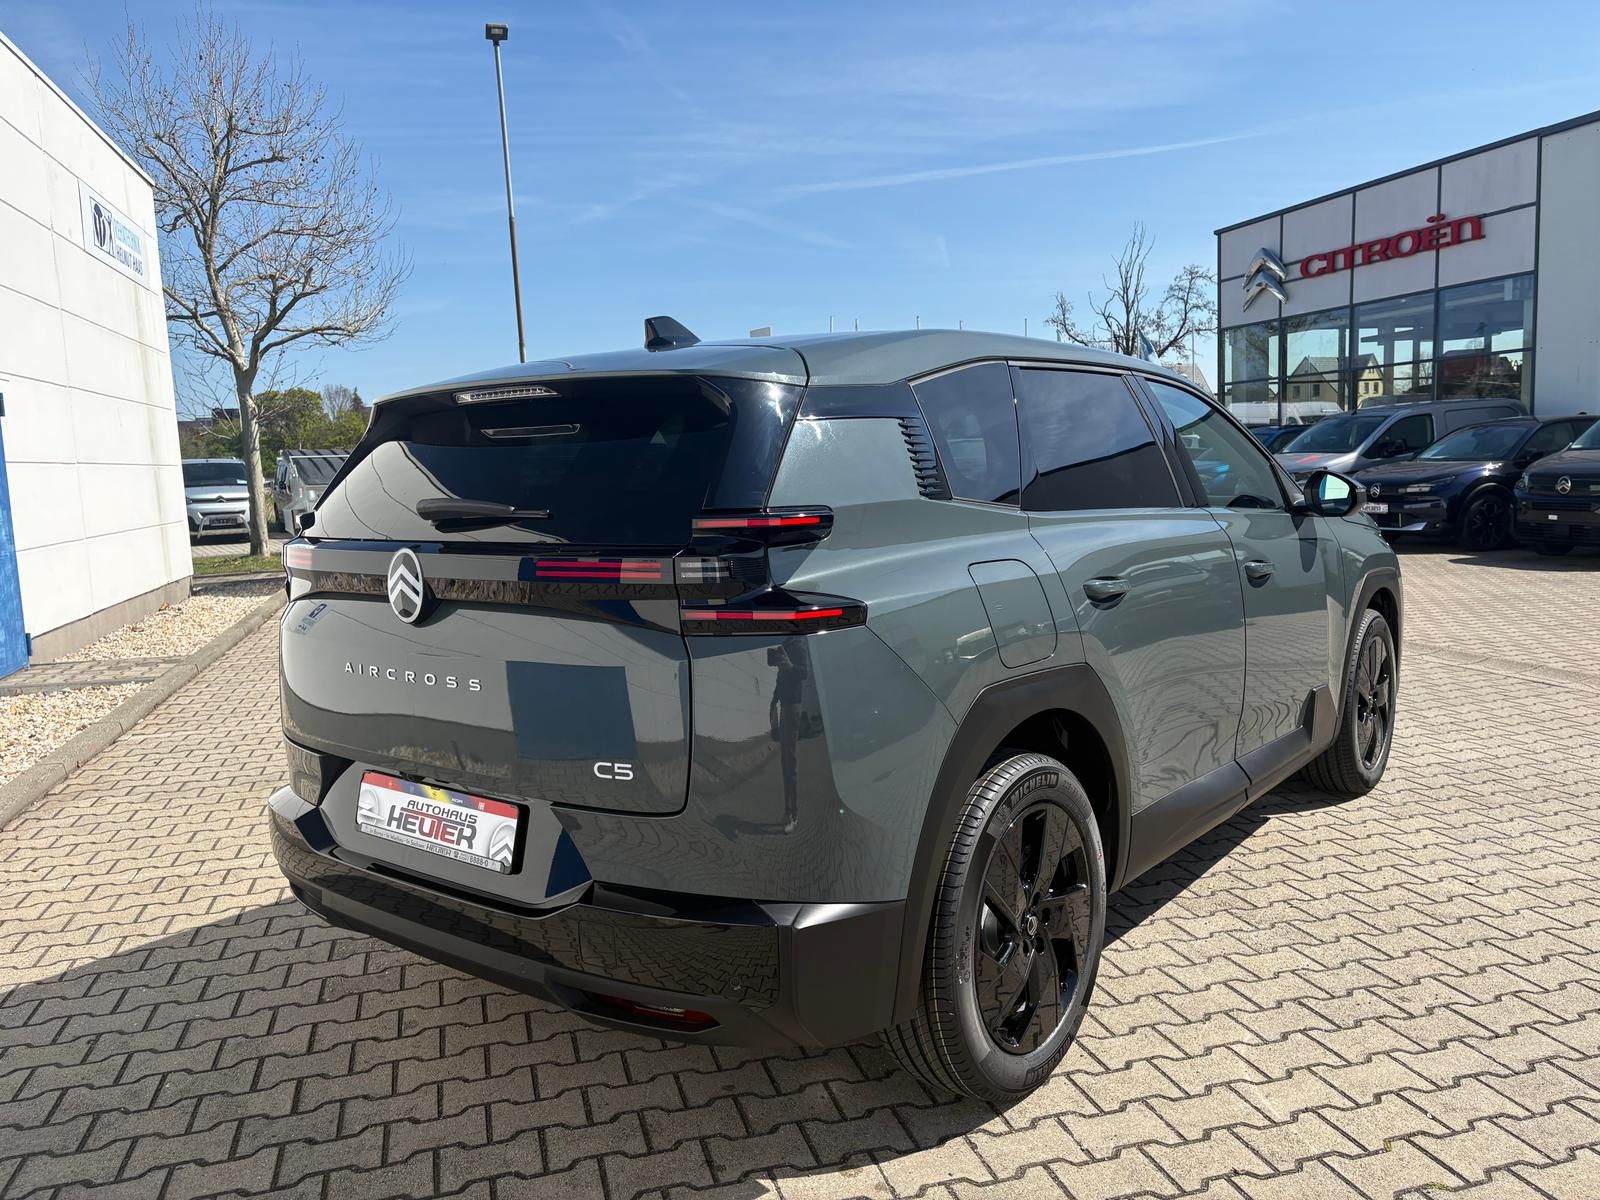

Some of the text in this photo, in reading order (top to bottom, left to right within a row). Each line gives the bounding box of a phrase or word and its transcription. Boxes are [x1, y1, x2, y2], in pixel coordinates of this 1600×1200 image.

[1300, 213, 1482, 279] CITROËN
[344, 662, 482, 692] AIRCROSS
[593, 761, 634, 781] C5
[1010, 773, 1058, 807] MICHELIN
[386, 804, 478, 850] HEUTER
[407, 800, 478, 825] AUTOHAUS
